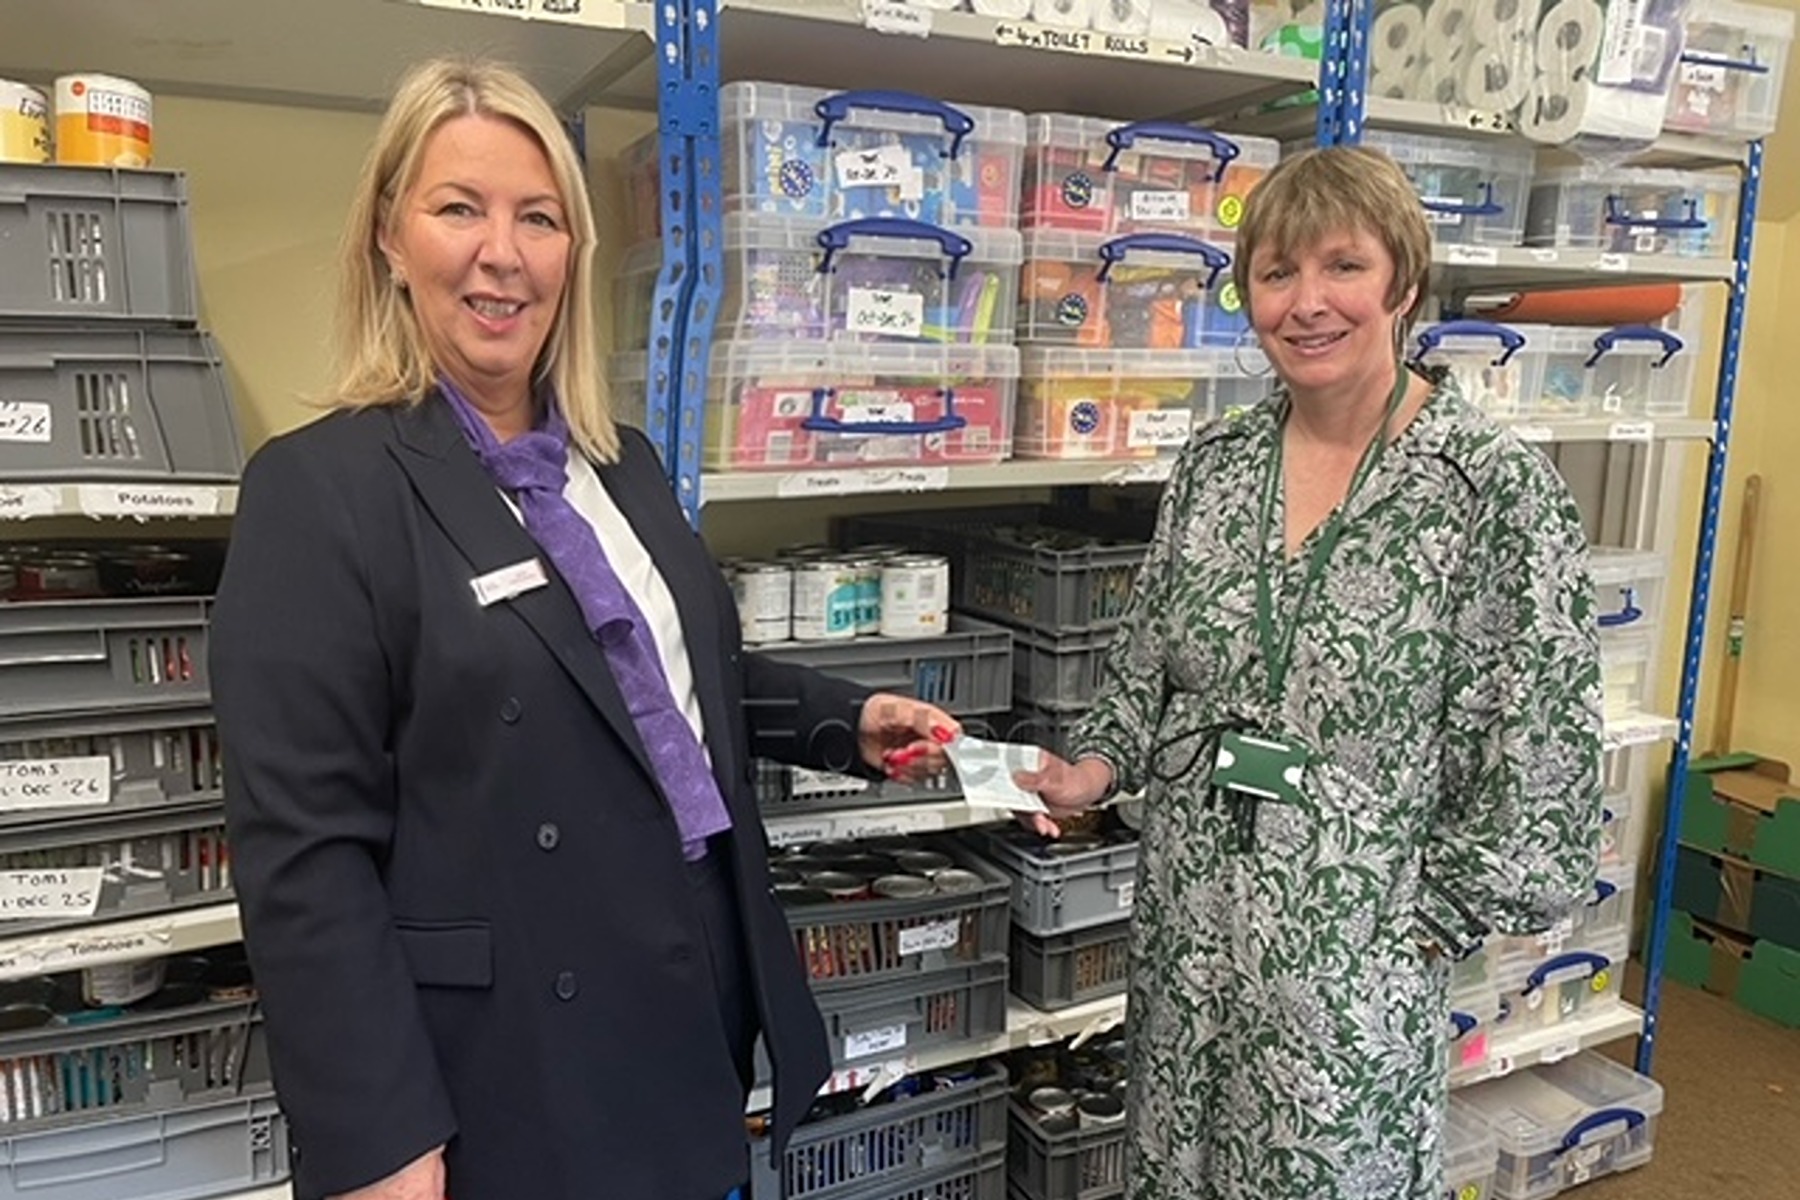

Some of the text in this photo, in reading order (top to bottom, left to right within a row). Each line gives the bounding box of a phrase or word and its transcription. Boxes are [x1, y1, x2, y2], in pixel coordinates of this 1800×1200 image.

[1105, 35, 1149, 54] ROLLS
[118, 492, 194, 507] Potatoes
[67, 938, 144, 956] Tomatoes
